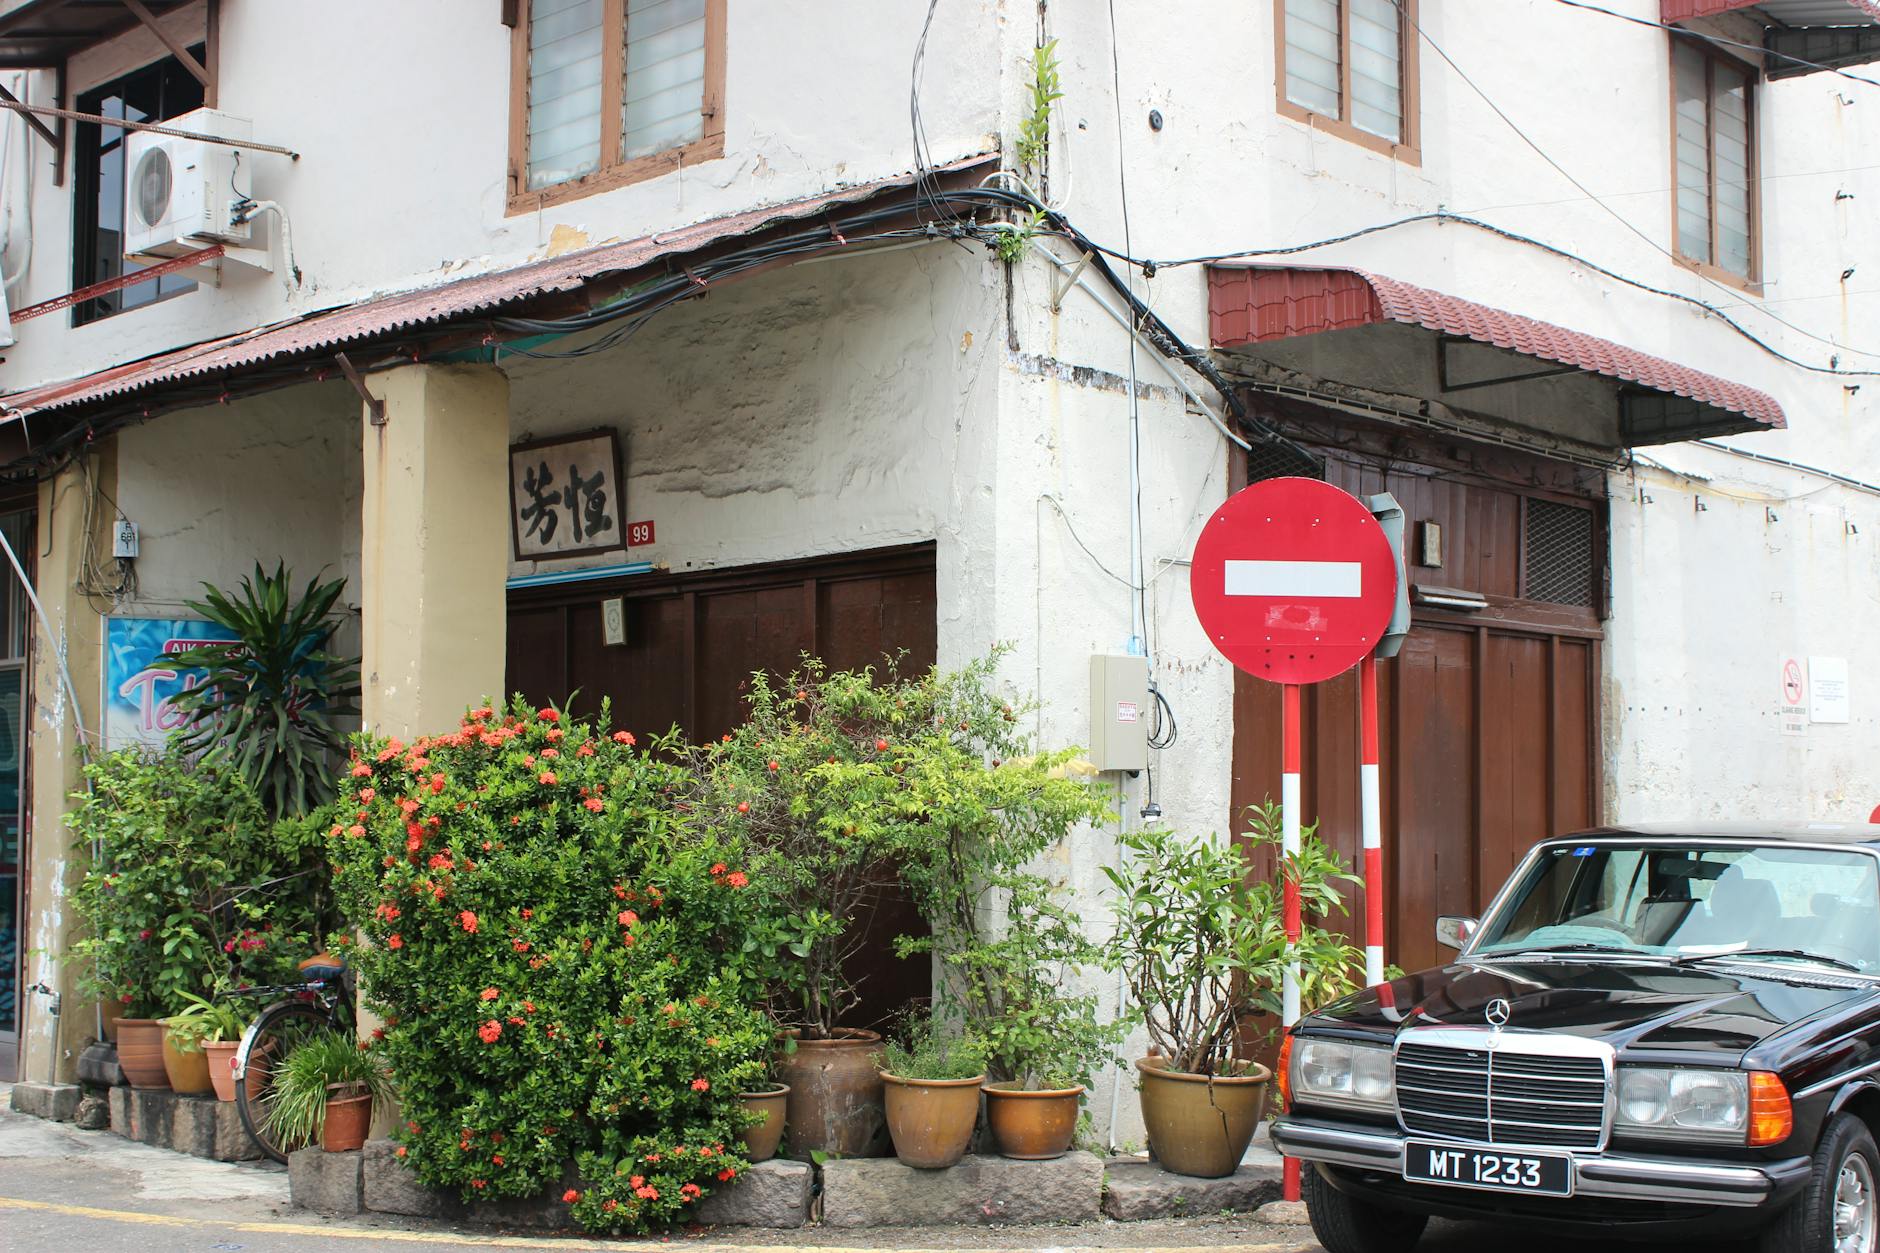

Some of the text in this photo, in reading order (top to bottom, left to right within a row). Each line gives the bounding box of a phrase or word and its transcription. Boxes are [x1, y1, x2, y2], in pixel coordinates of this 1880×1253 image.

[632, 524, 649, 543] 99
[1429, 1149, 1541, 1188] MT 1233
